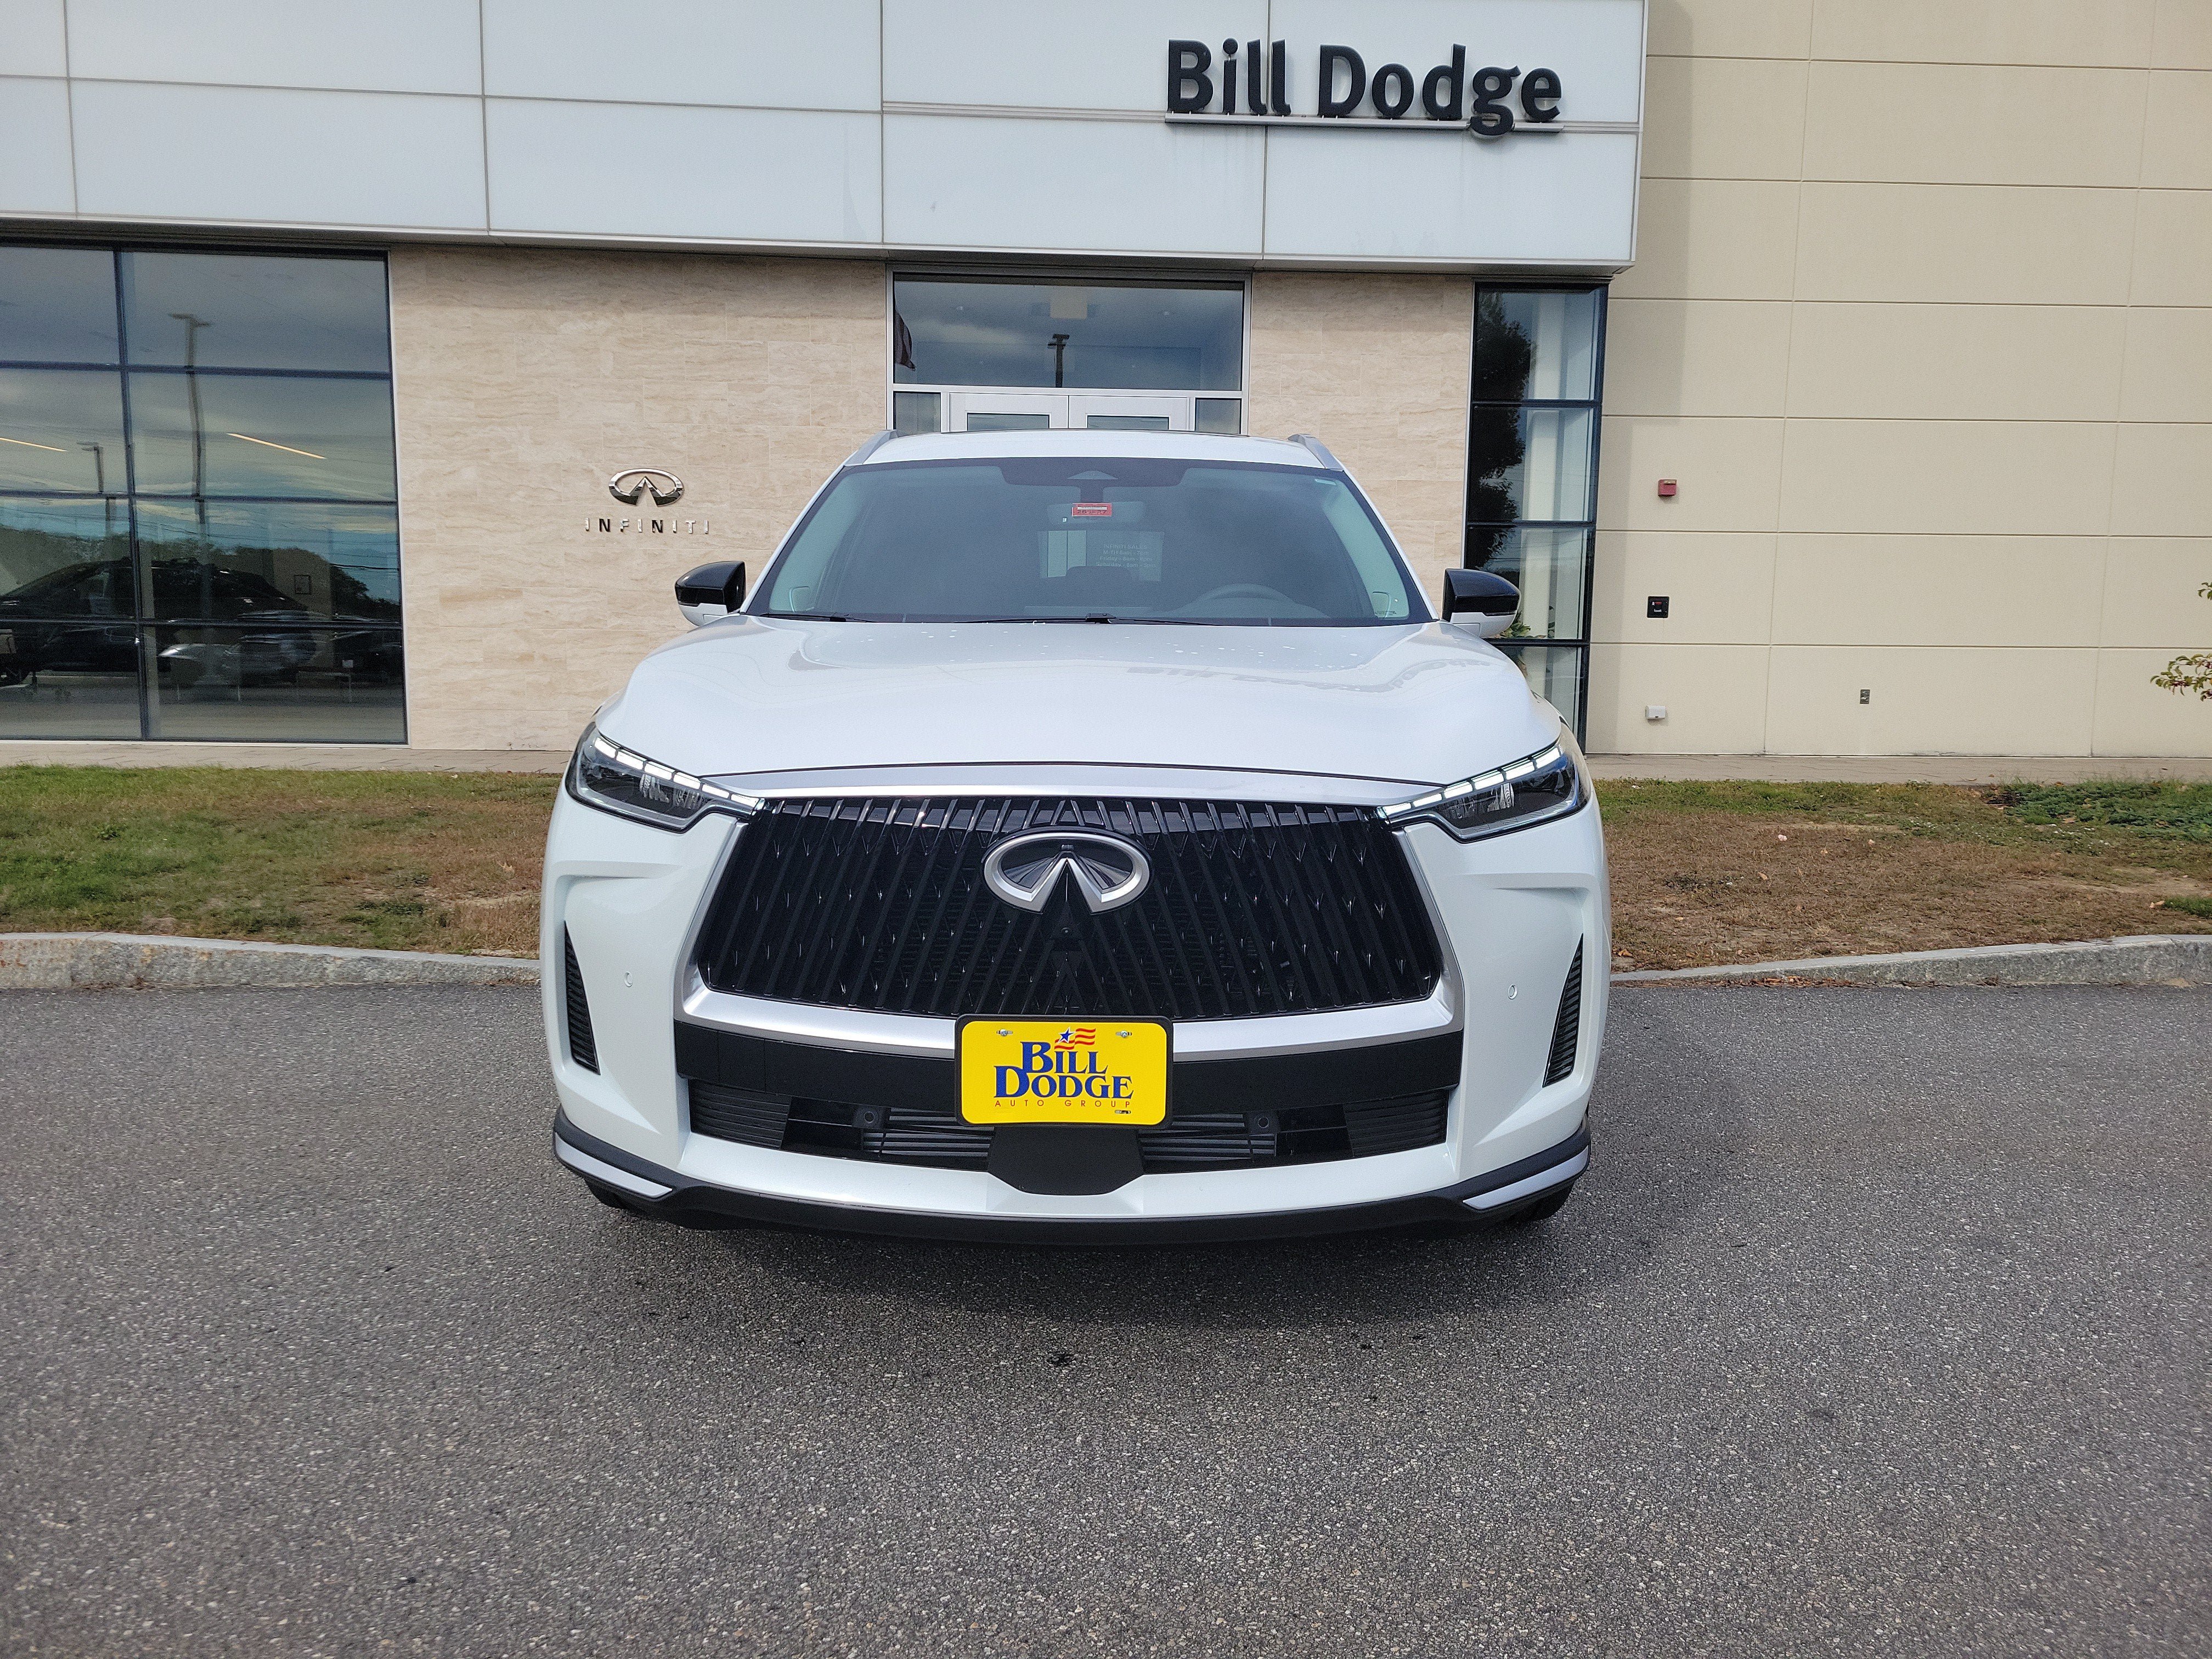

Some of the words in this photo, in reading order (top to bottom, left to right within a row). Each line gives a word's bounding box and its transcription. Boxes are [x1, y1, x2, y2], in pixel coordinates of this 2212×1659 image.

[1167, 38, 1291, 115] Bill
[1318, 43, 1562, 136] Dodge
[585, 517, 709, 534] INFINITI
[1020, 1041, 1108, 1074] BILL
[994, 1065, 1134, 1099] DODGE
[995, 1099, 1045, 1108] AUTO
[1064, 1099, 1131, 1108] GROUP
